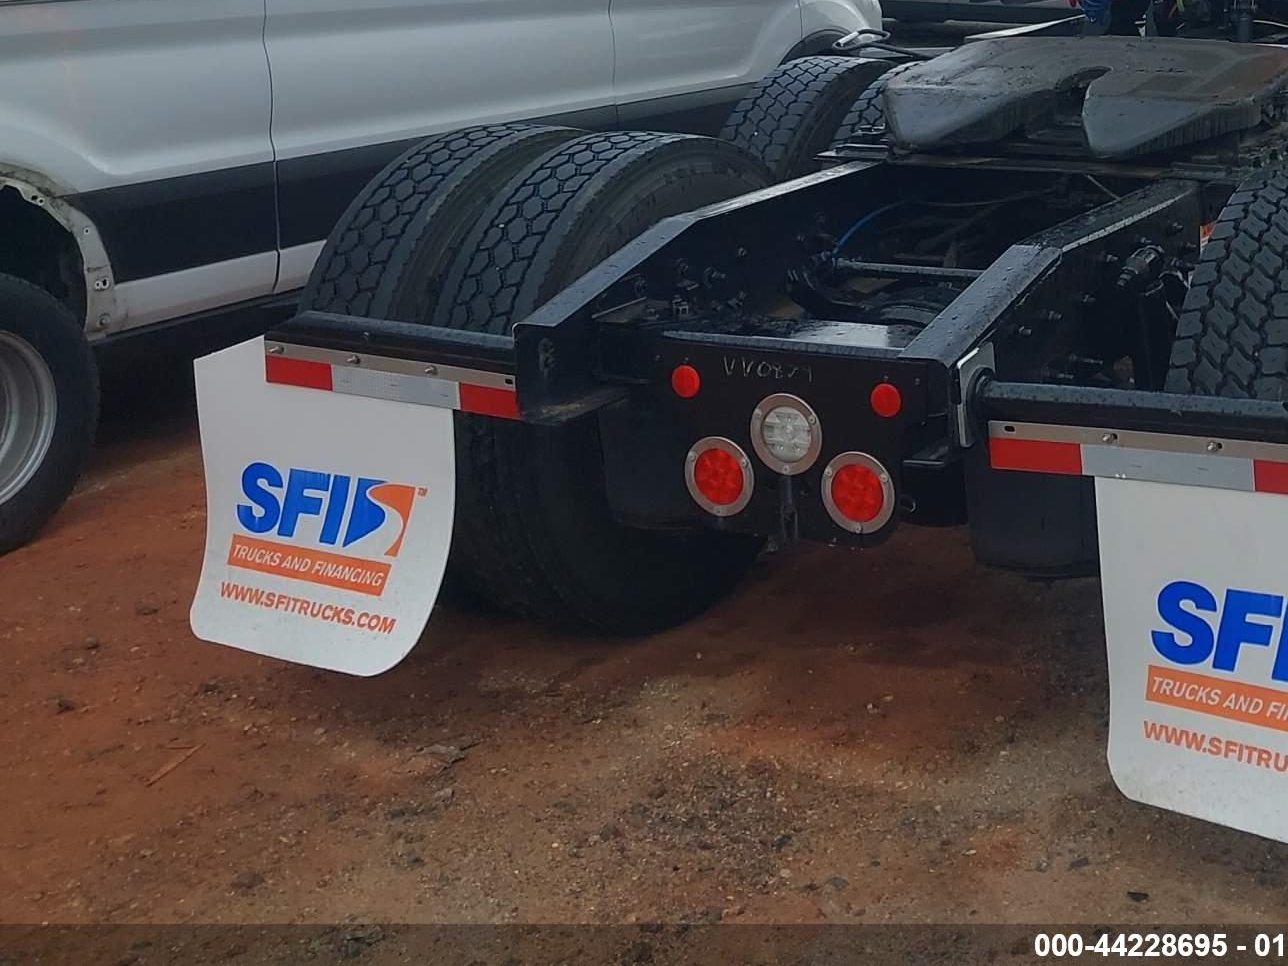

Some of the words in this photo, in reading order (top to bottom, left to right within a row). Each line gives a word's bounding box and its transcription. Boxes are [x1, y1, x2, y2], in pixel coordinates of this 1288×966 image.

[236, 462, 352, 545] SFI
[232, 544, 280, 568] TRUCKS
[281, 555, 311, 573] AND
[312, 560, 385, 587] FINANCING
[220, 581, 397, 634] WWW.SFITRUCKS.COM
[1152, 676, 1220, 706] TRUCKS
[1223, 692, 1264, 716] AND
